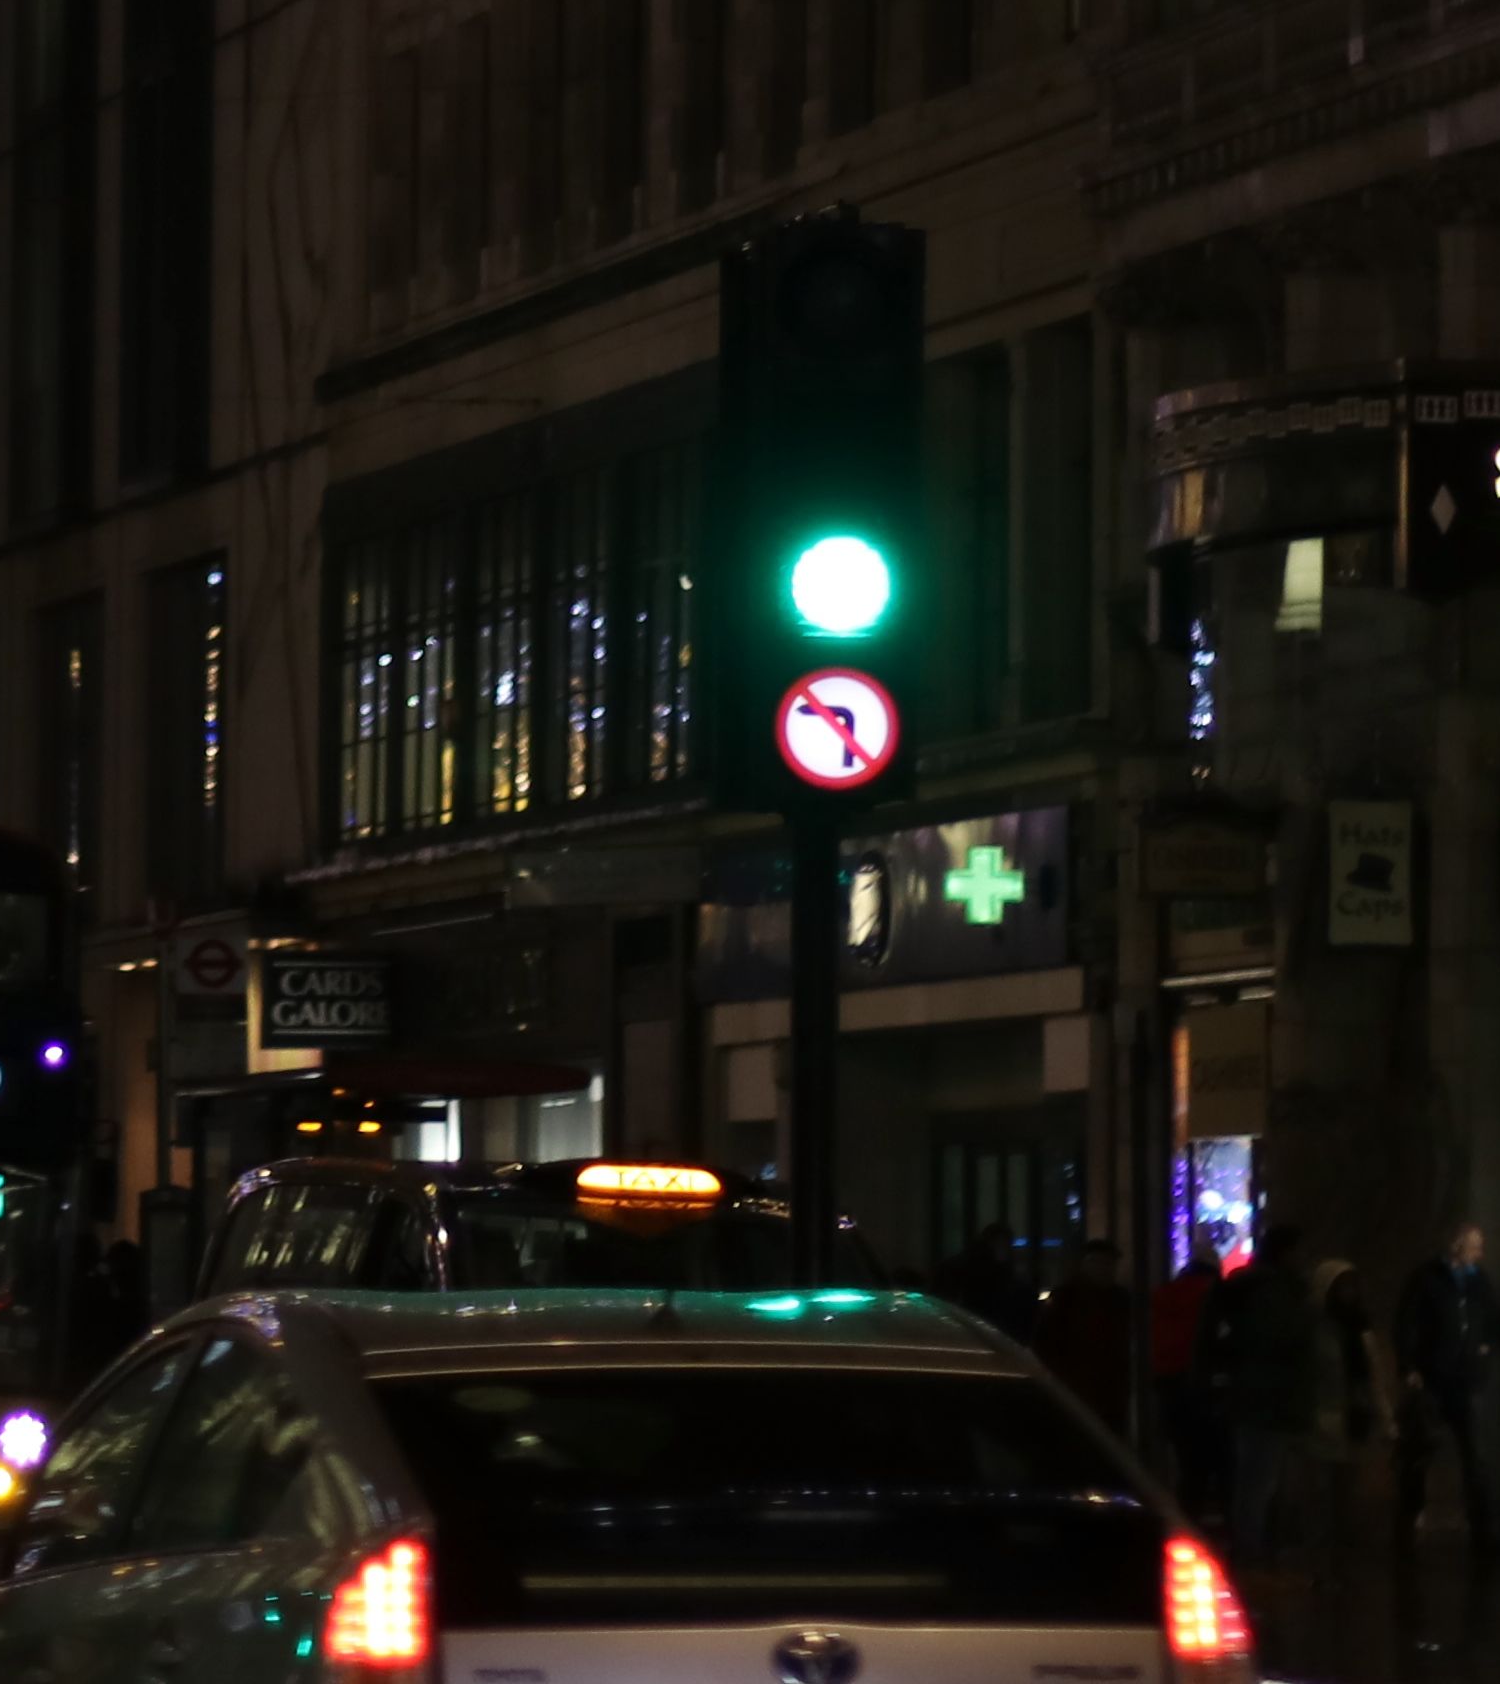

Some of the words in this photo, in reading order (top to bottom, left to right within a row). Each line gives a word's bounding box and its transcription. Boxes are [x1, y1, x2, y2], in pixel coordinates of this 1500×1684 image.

[1339, 821, 1404, 847] Hats
[1337, 891, 1404, 921] Caps
[280, 968, 383, 997] CARDS
[271, 1000, 390, 1027] GALORE
[619, 1170, 694, 1191] TAXI
